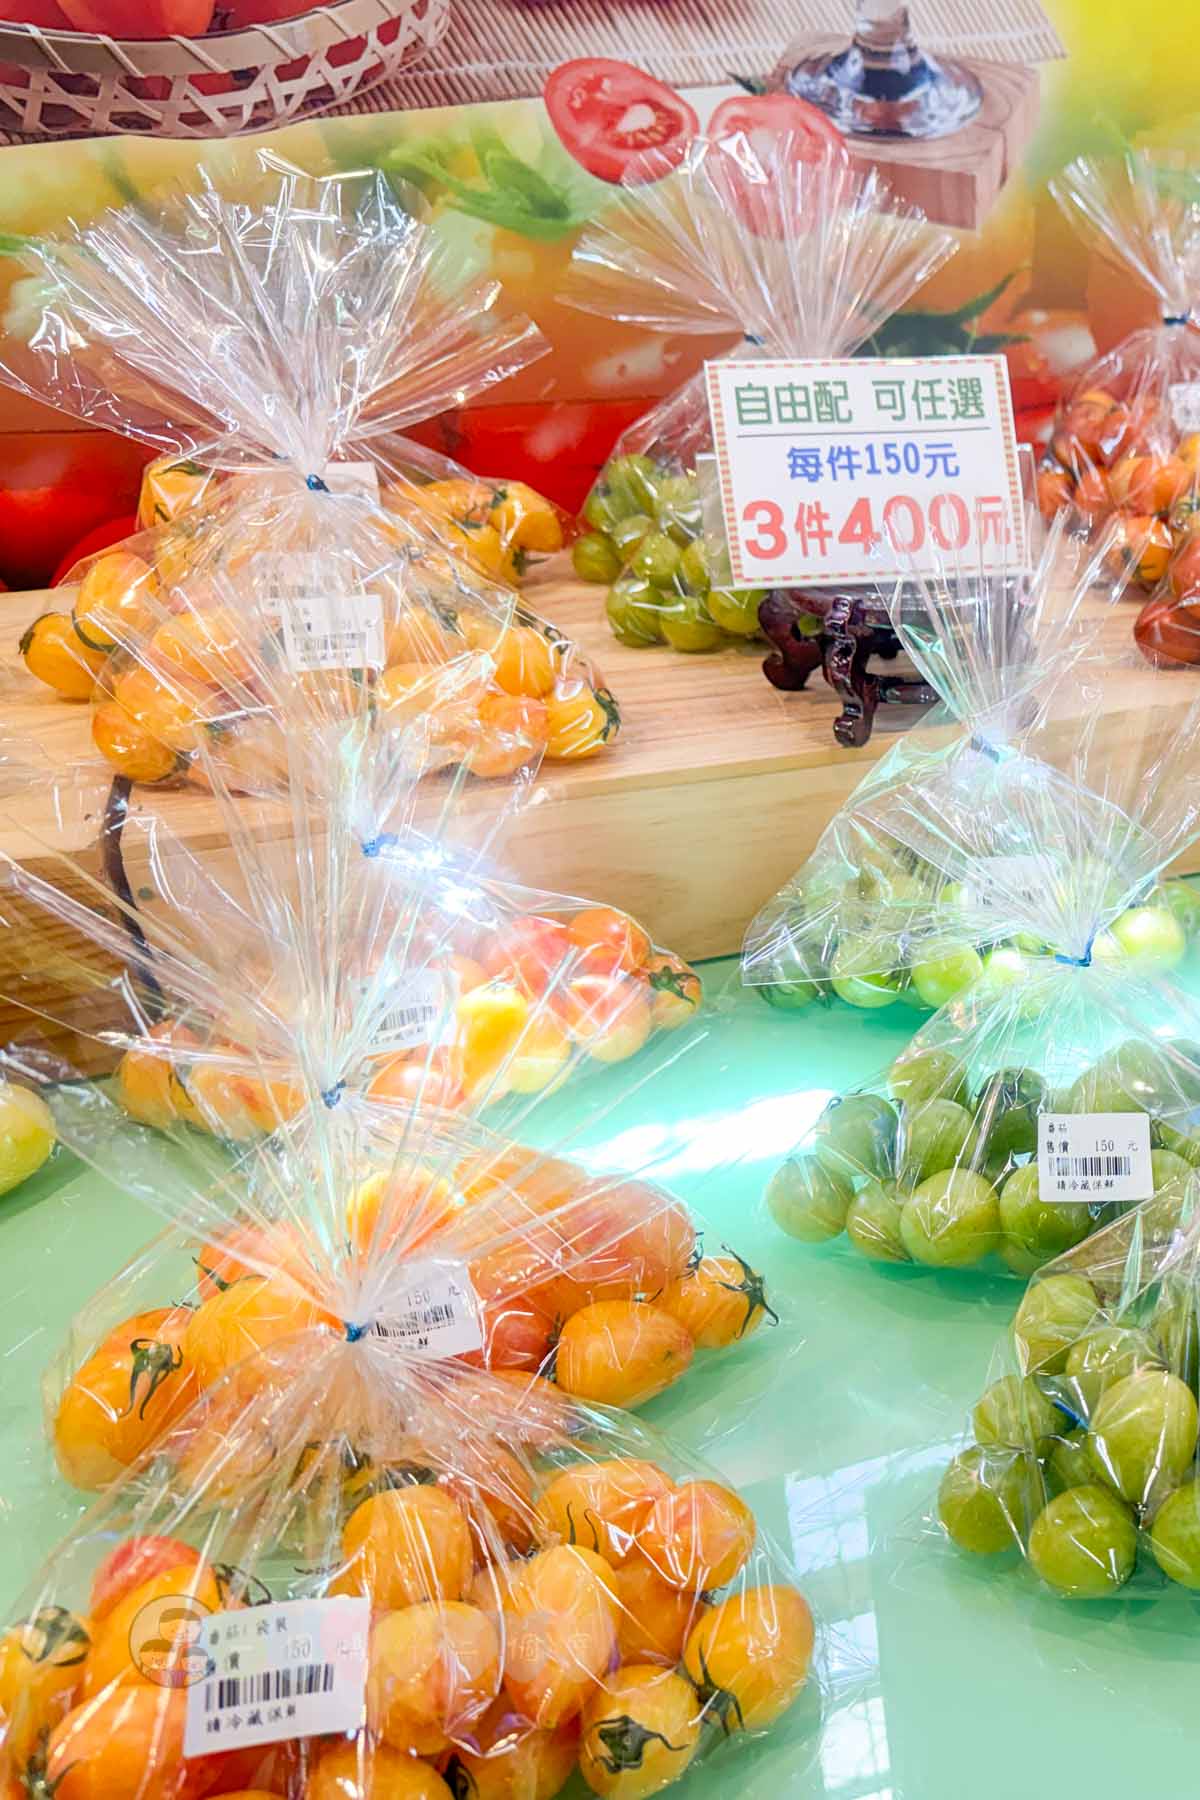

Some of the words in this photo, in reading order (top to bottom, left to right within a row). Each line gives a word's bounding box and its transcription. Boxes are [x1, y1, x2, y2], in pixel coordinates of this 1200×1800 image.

[735, 380, 853, 426] 自由配
[871, 377, 986, 422] 可任選
[786, 442, 961, 483] 每件150元
[742, 493, 1012, 561] 3件400元
[1094, 1140, 1115, 1153] 150
